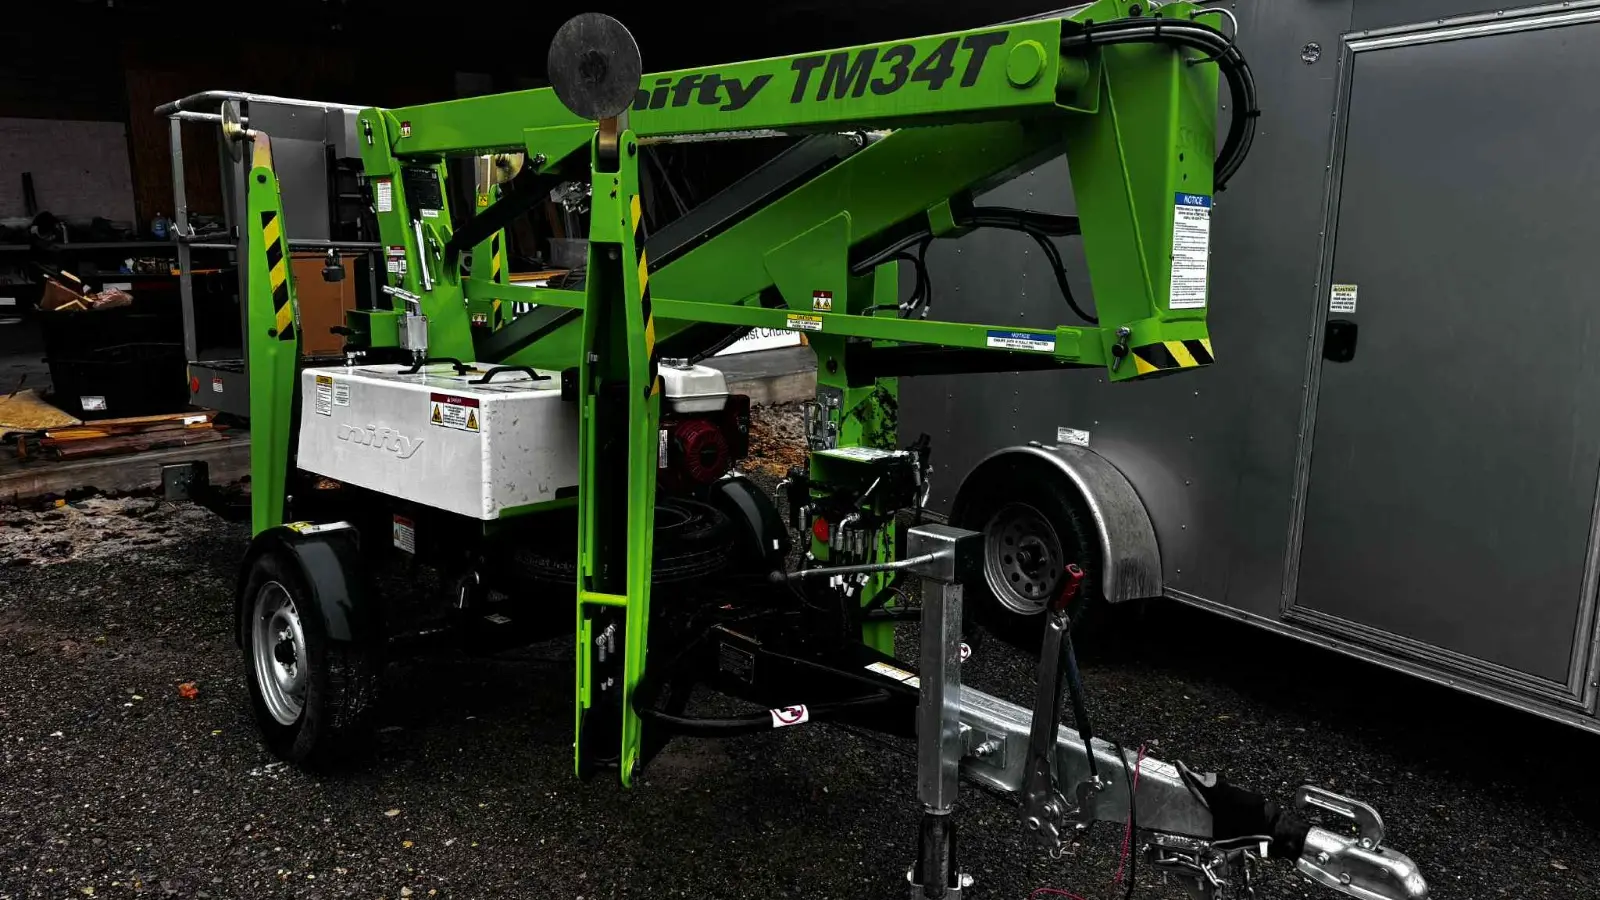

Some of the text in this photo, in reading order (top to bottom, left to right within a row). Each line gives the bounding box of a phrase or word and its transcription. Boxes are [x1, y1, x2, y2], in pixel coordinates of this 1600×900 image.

[790, 31, 1010, 104] TM34T
[1183, 195, 1203, 205] NOTICE
[1010, 331, 1031, 339] NOTICE
[337, 423, 424, 459] nifty
